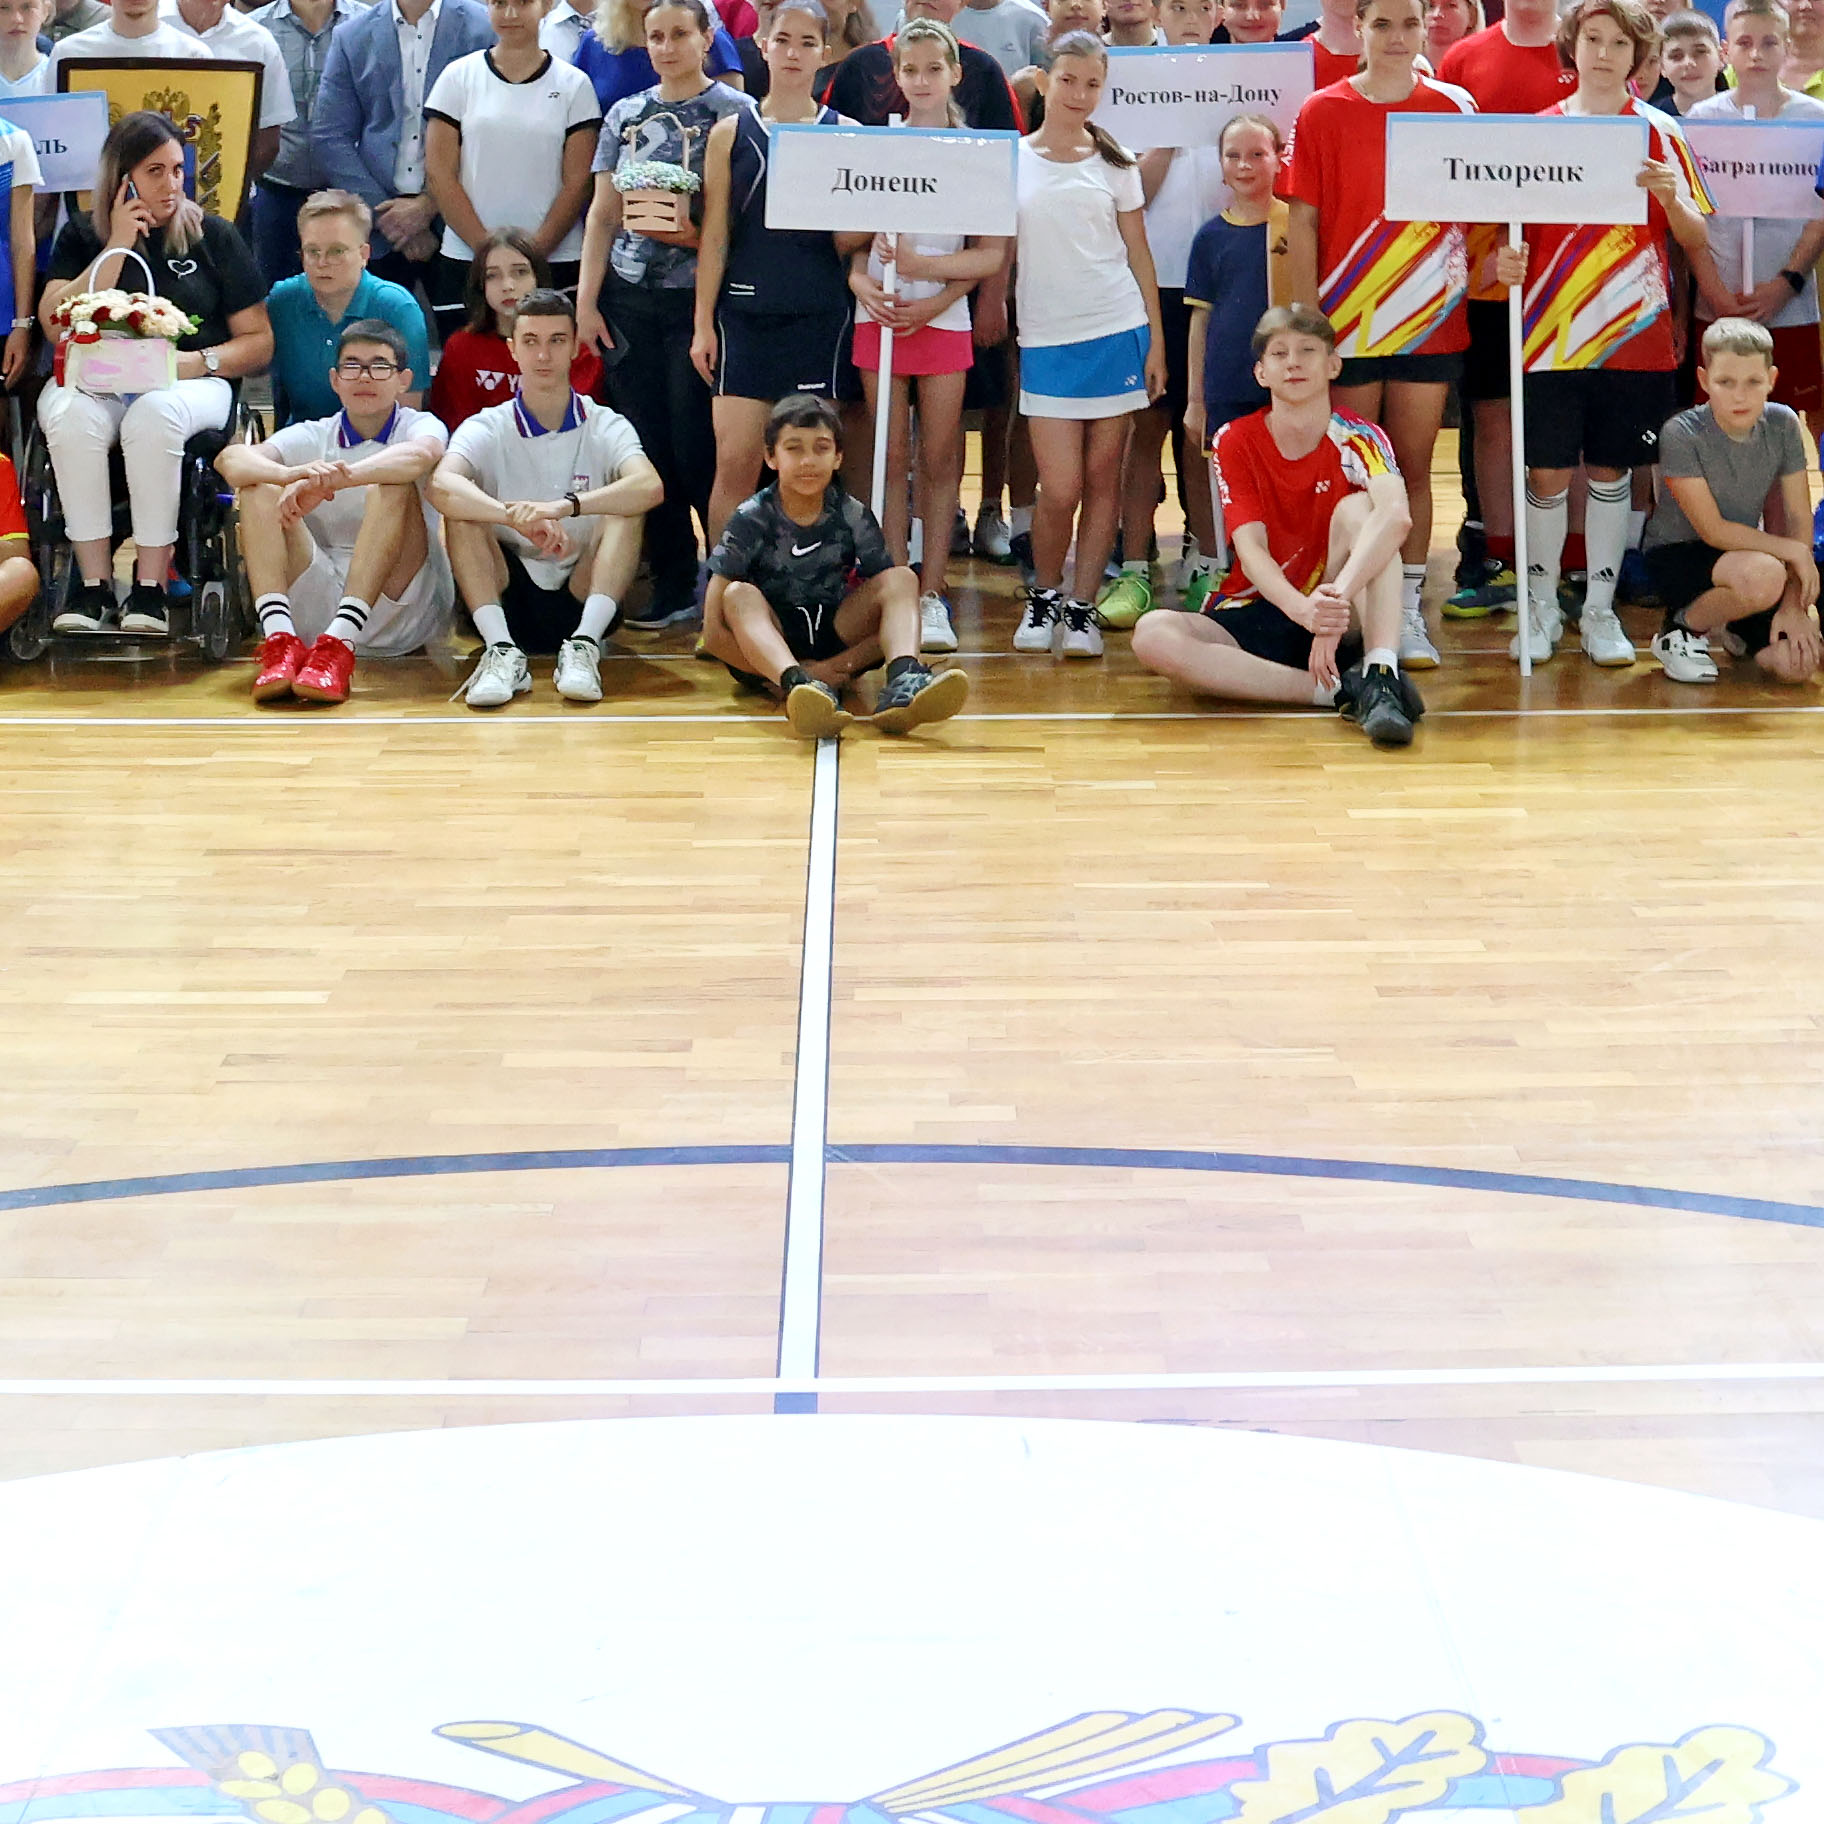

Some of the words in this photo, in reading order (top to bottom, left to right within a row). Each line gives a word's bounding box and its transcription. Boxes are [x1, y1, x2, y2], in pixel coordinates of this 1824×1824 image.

[1111, 83, 1282, 107] Ростов-на-Дону
[831, 167, 938, 195] Донецк
[1442, 156, 1585, 188] Тихорецк
[1700, 156, 1819, 180] агратионо
